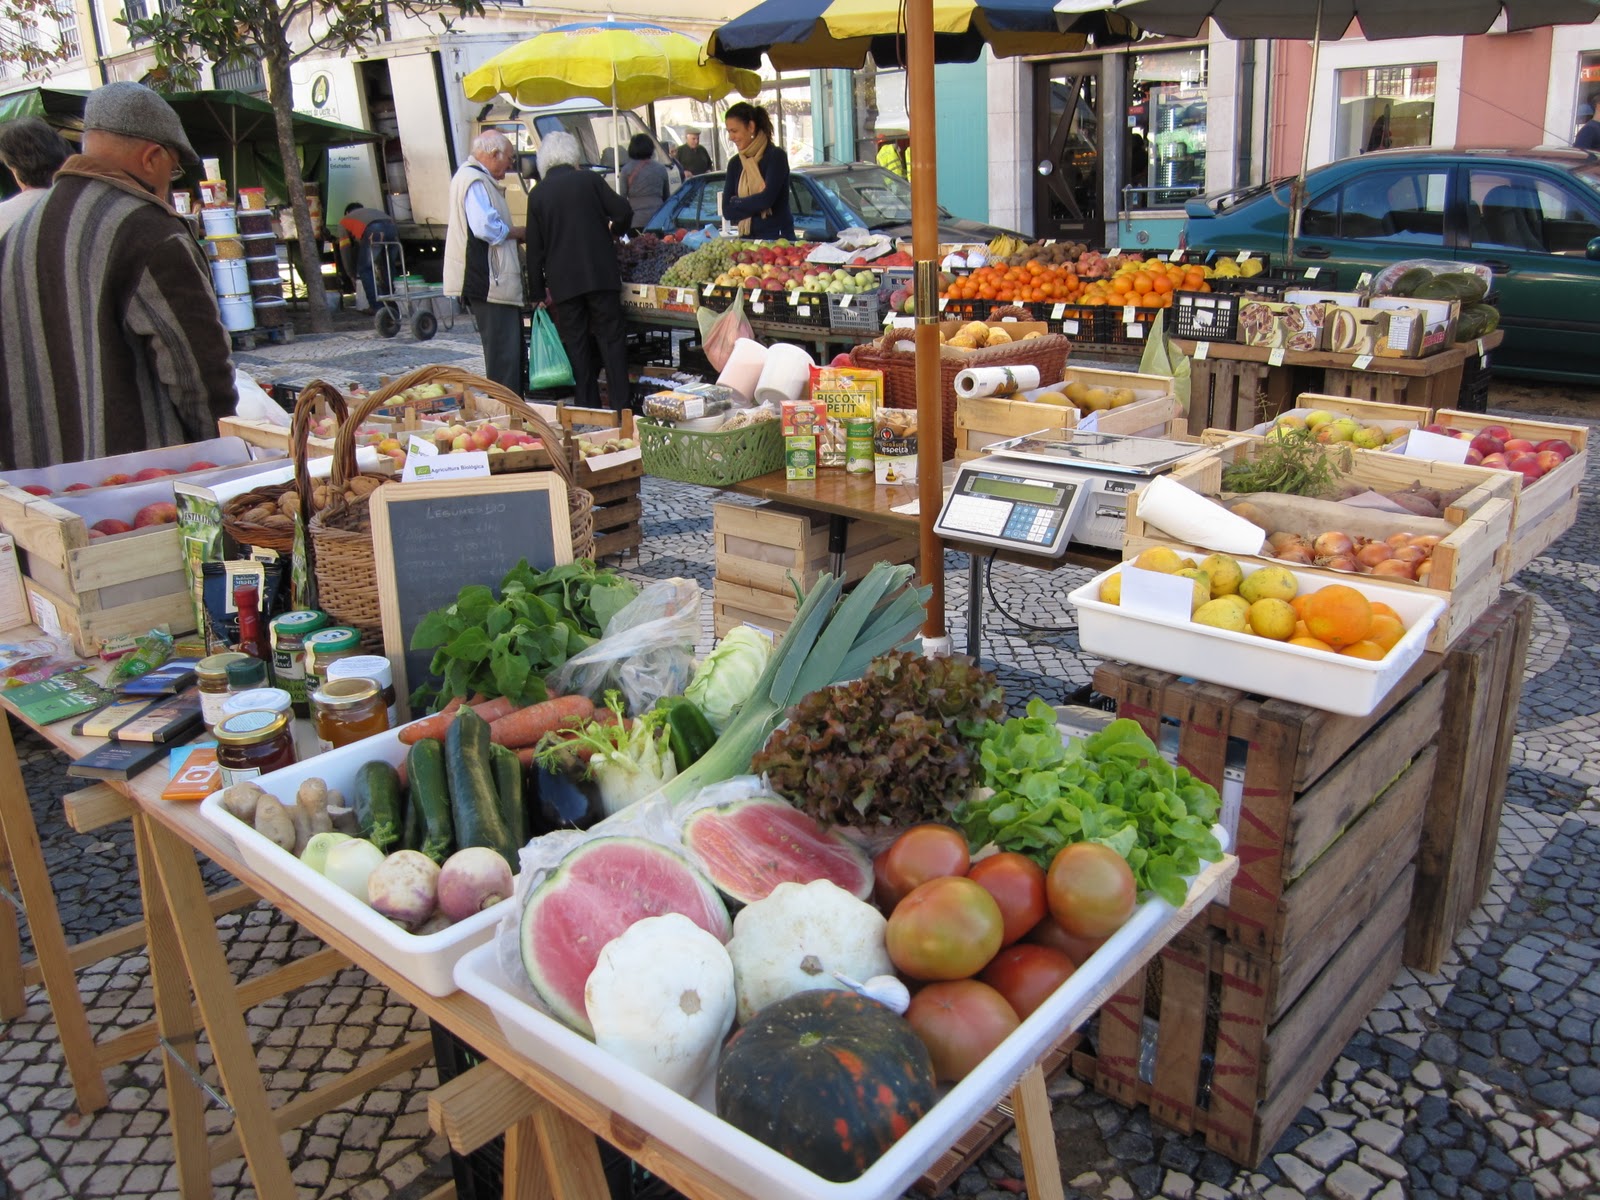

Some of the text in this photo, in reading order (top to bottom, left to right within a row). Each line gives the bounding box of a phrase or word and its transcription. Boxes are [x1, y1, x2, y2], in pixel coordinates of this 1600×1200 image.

[817, 394, 866, 404] BISCOTTI
[826, 403, 857, 413] PETIT
[431, 464, 485, 474] Agricultura Biológica
